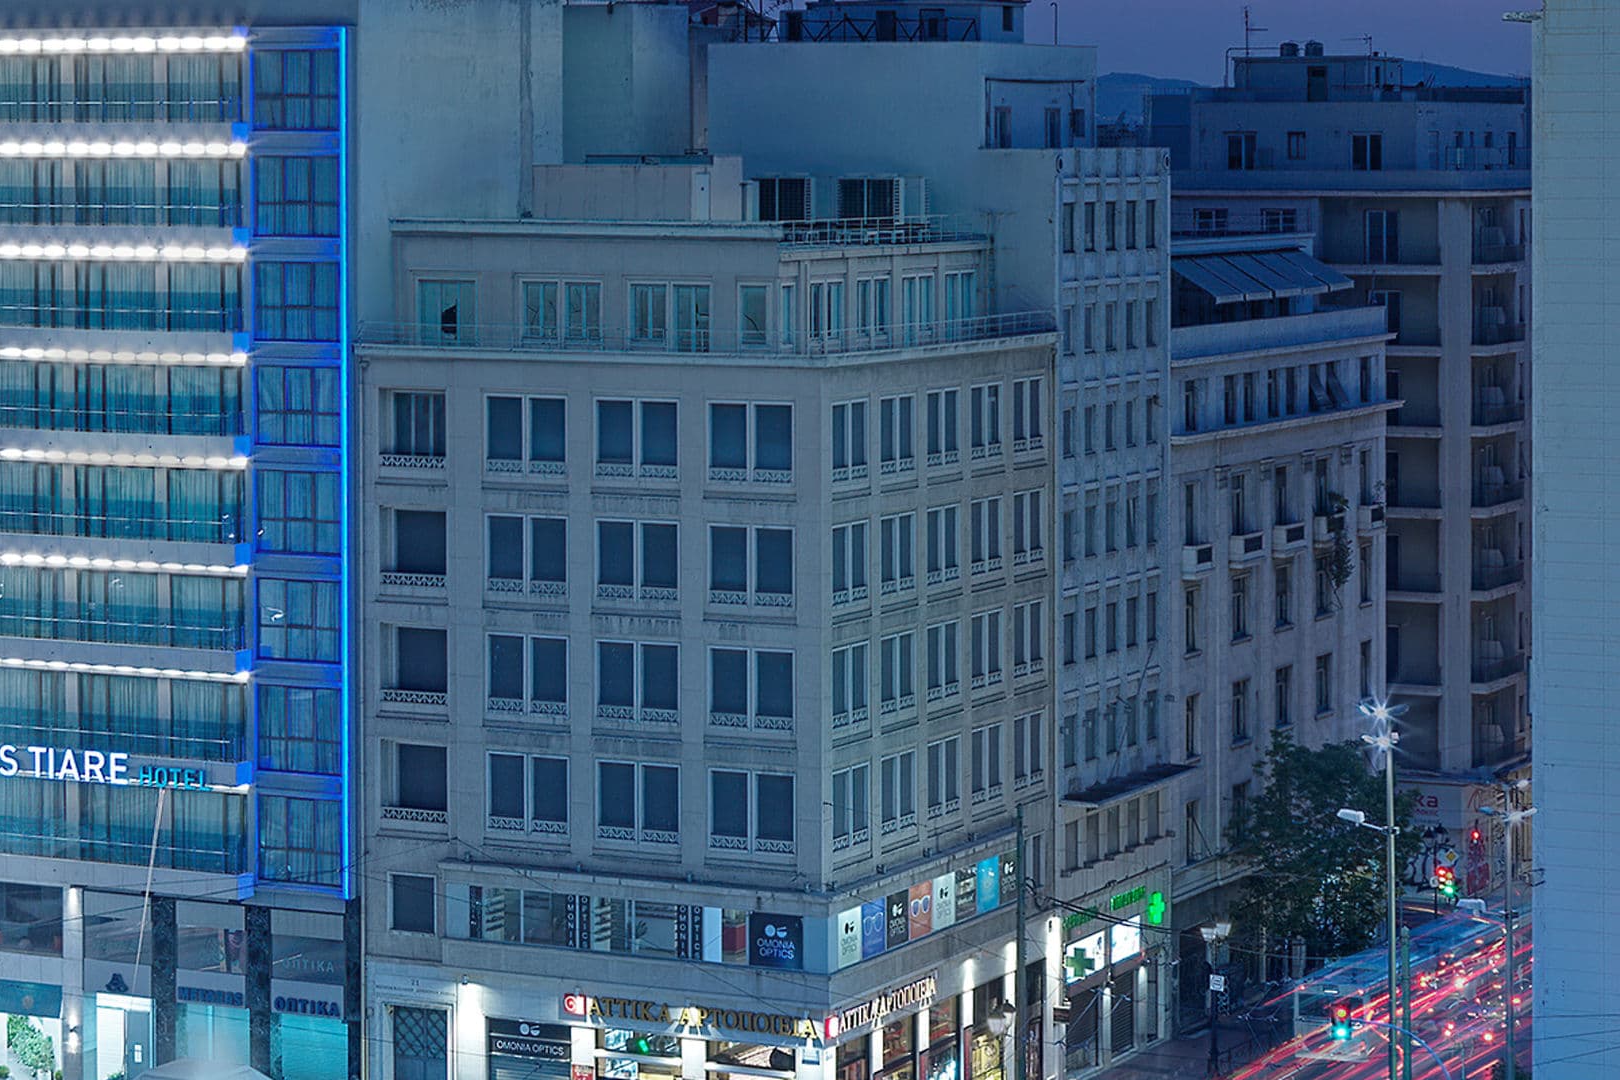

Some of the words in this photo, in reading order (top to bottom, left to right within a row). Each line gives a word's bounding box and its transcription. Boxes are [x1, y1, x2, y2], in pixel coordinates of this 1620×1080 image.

[28, 746, 129, 785] TIARE
[138, 765, 213, 792] HOTEL
[566, 894, 575, 947] OMONIA
[679, 903, 687, 958] OMONIA
[756, 937, 795, 950] OMONIA
[759, 947, 795, 960] OPTICS
[274, 996, 341, 1017] ΟΠΤΙΚΑ
[496, 1040, 531, 1052] OMONIA
[532, 1043, 565, 1056] OPTICS
